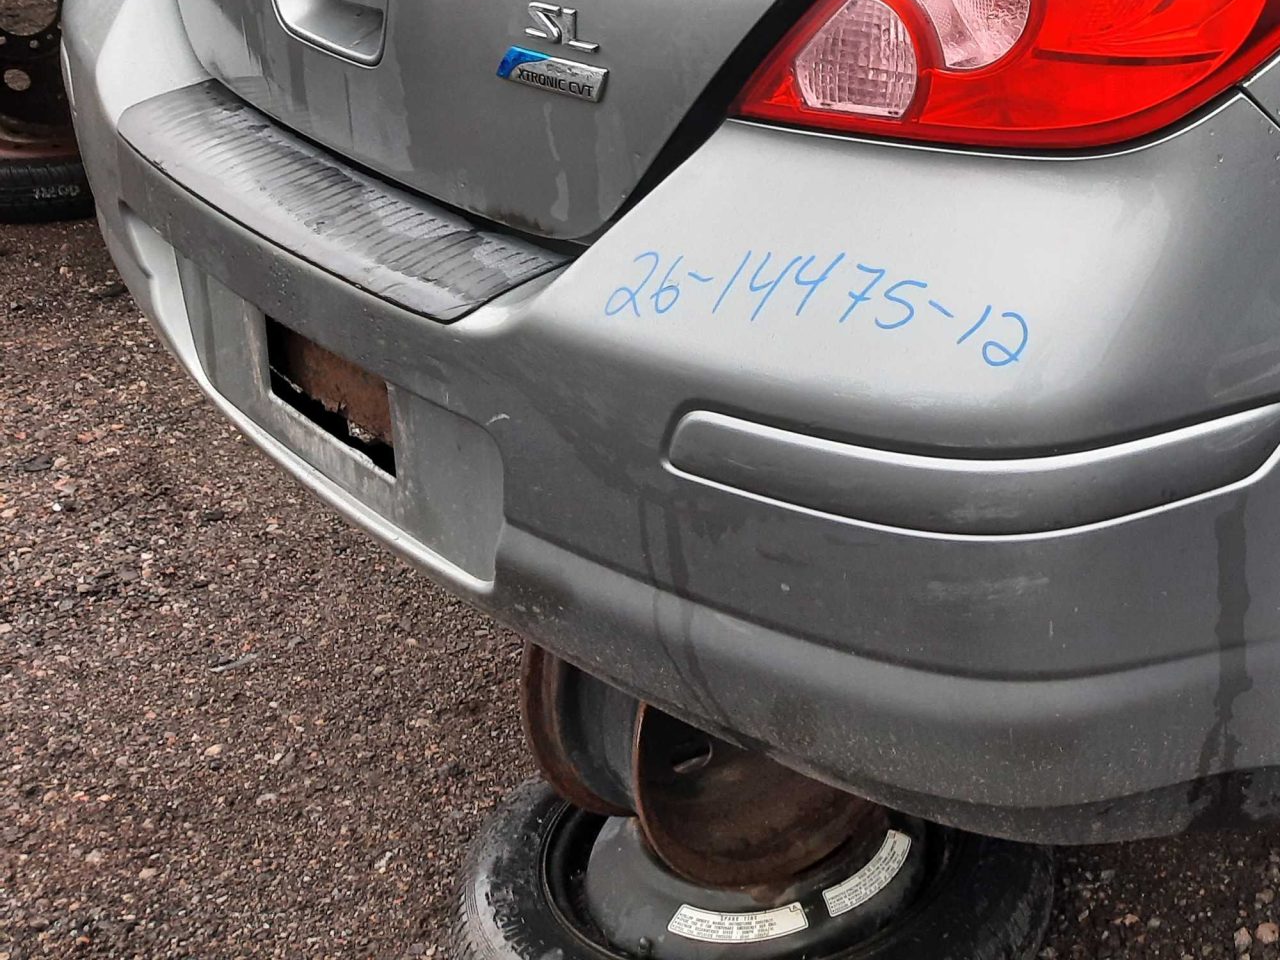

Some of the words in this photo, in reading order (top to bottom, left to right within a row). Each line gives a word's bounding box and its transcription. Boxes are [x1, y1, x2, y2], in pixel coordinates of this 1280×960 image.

[525, 1, 599, 53] SL
[518, 68, 566, 91] XTRONIC
[569, 81, 594, 97] CVT
[604, 251, 1029, 367] 26-14475-12
